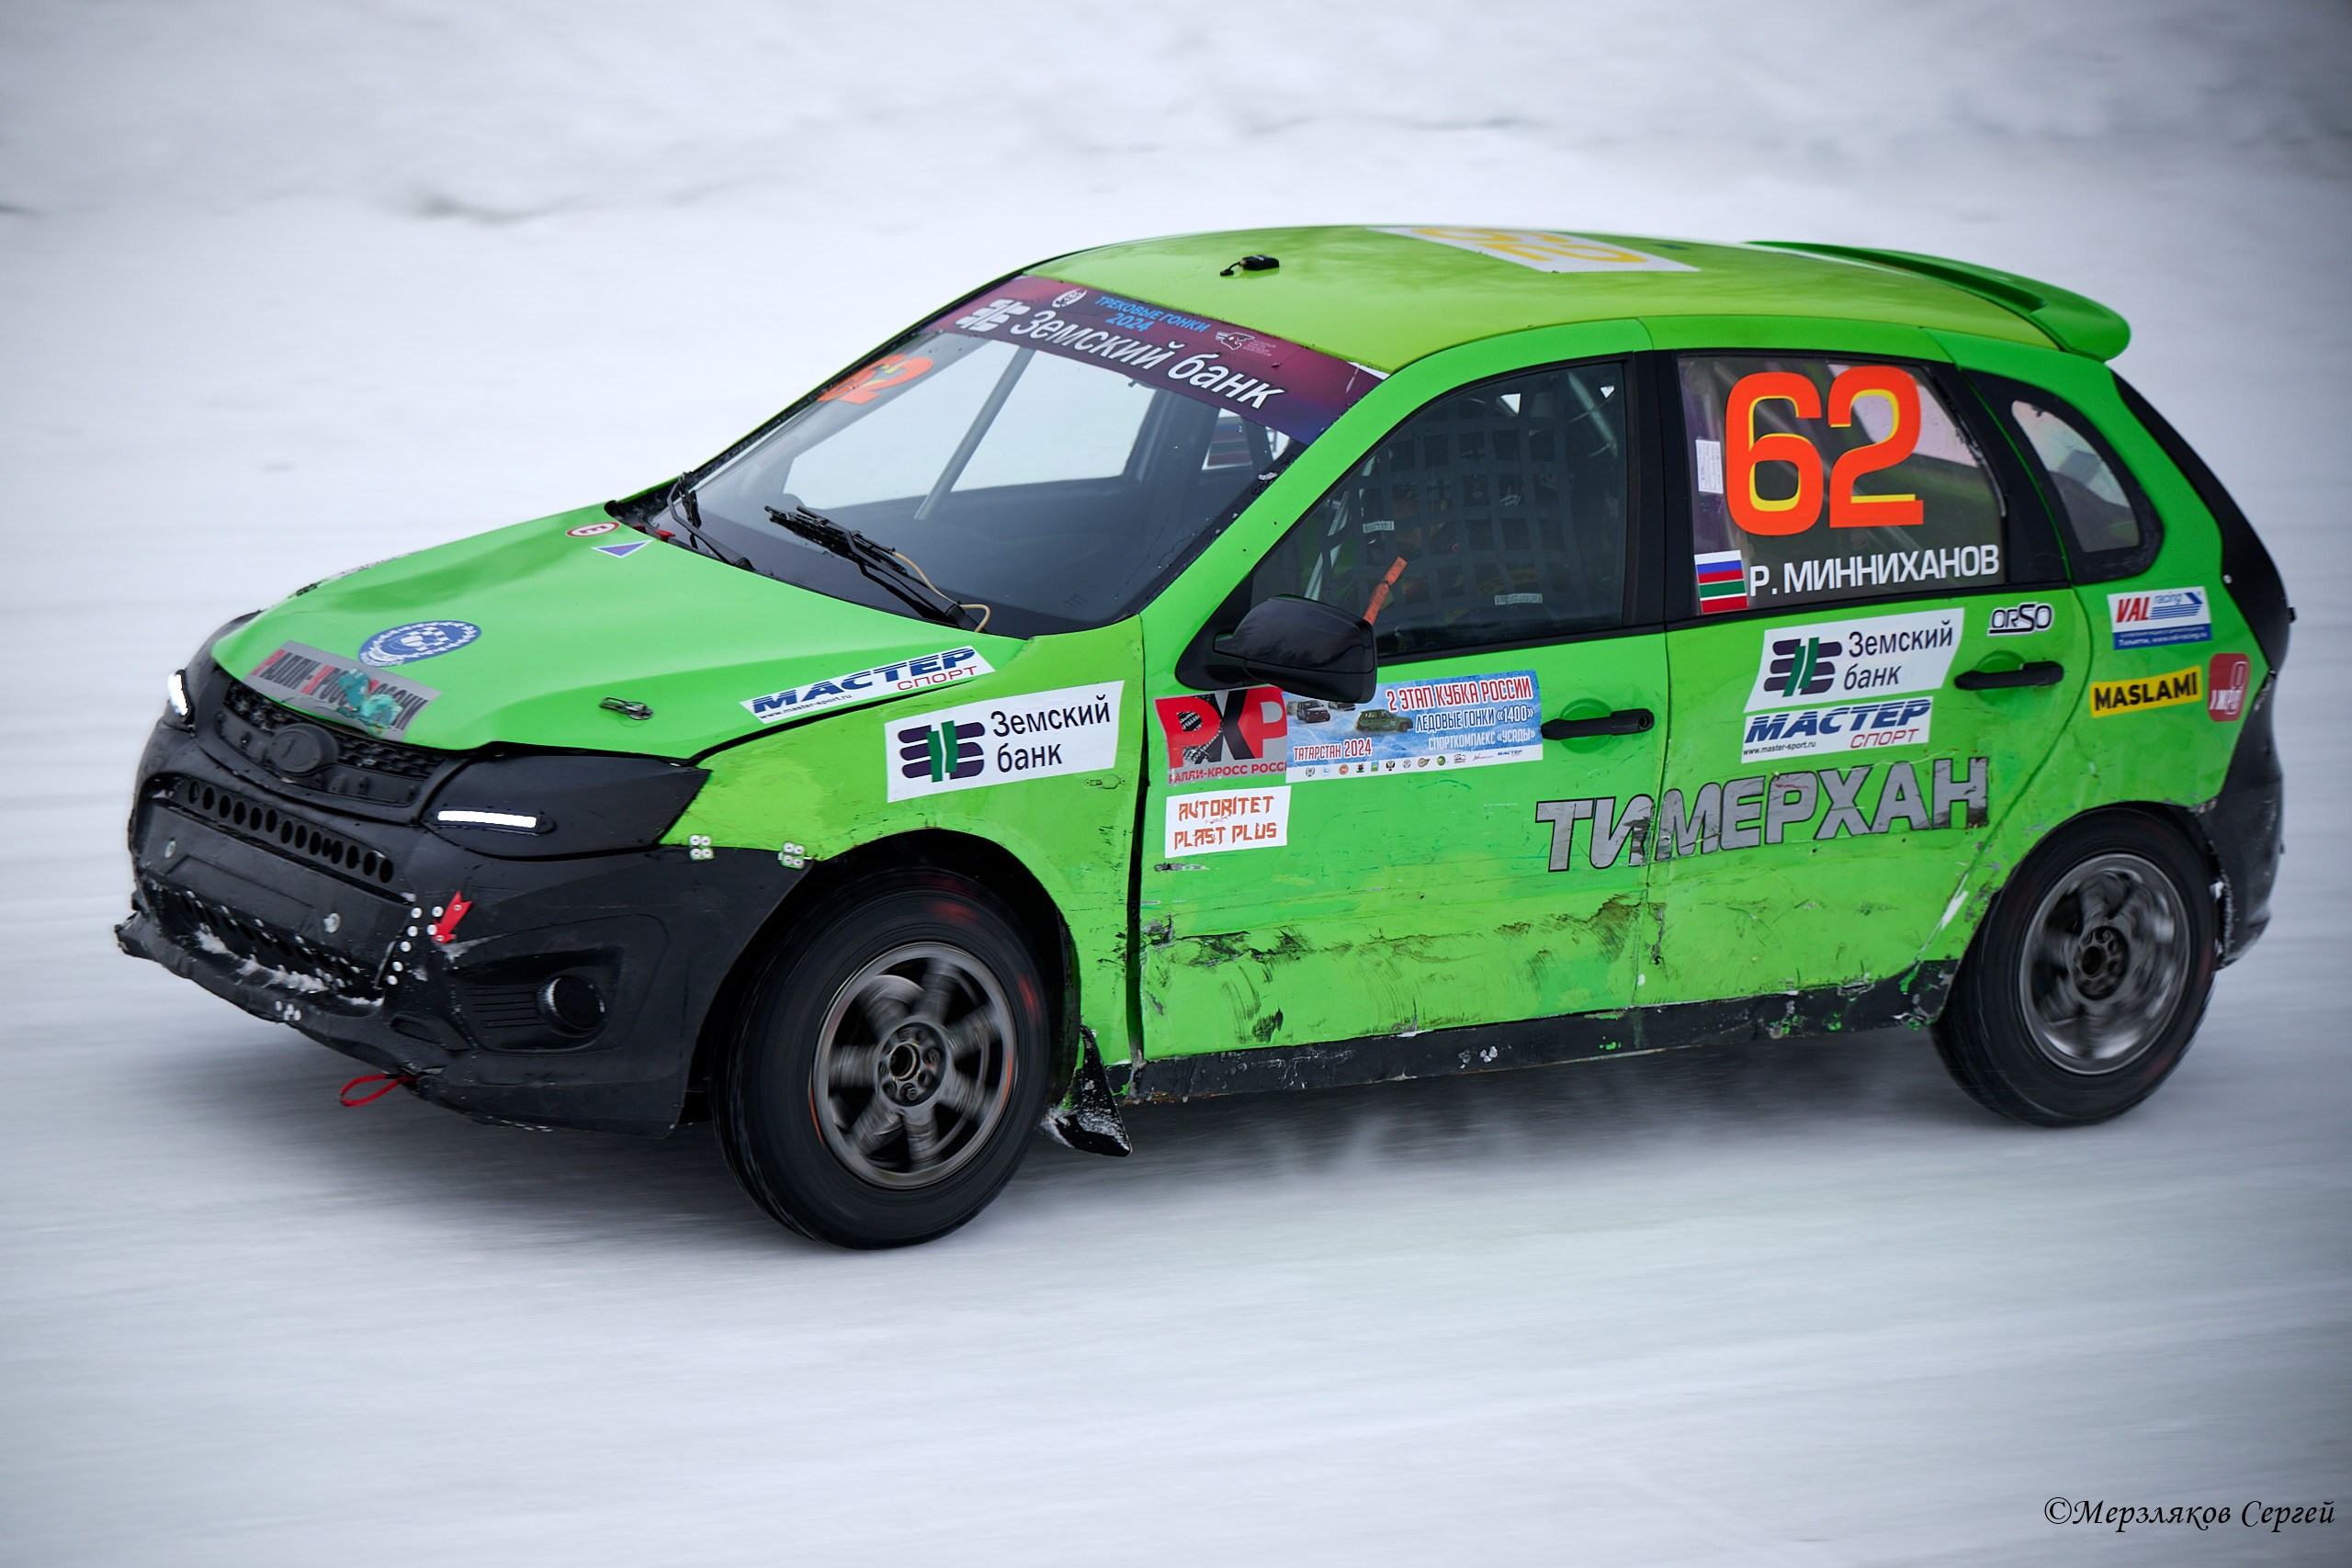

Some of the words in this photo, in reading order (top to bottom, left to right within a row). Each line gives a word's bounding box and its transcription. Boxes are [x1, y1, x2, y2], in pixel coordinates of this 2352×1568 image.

[1095, 297, 1163, 320] ТРЕКОВЫЕ
[1159, 313, 1211, 333] ГОНКИ
[1105, 313, 1155, 332] 2024
[1010, 310, 1178, 369] Земский
[1168, 351, 1286, 409] банк
[1725, 366, 1924, 536] 62
[1749, 565, 1778, 598] Р.
[1783, 544, 2000, 594] МИННИХАНОВ
[2116, 597, 2150, 624] VAL
[1849, 619, 1954, 658] Земский
[752, 648, 976, 714] МАСТЕР
[897, 665, 978, 691] СПОРТ
[1843, 663, 1902, 691] банк
[2095, 671, 2197, 711] MASLAMI
[758, 694, 853, 719] www.master-sport.ru
[1386, 691, 1397, 711] 2
[1399, 687, 1434, 709] ЭТАП
[1436, 682, 1478, 707] КУБКА
[1480, 677, 1532, 702] РОССИИ
[990, 694, 1111, 738] Земский
[1416, 711, 1462, 733] ЛЕДОВЫЕ
[1464, 708, 1496, 728] ГОНКИ
[1497, 704, 1534, 725] «1400»
[1745, 699, 1931, 743] МАСТЕР
[1294, 745, 1341, 761] ТАТАРСТАН
[1344, 738, 1373, 758] 2024
[1429, 731, 1496, 750] СПОРТКОМПЛЕКС
[1497, 727, 1536, 745] «УСАДЫ»
[1743, 741, 1816, 756] www.master-sport.ru
[1849, 728, 1919, 749] СПОРТ
[996, 742, 1063, 773] банк
[1535, 758, 1989, 873] ТИМЕРХАН
[1174, 826, 1227, 851] PLAST
[1232, 822, 1277, 844] PLUS
